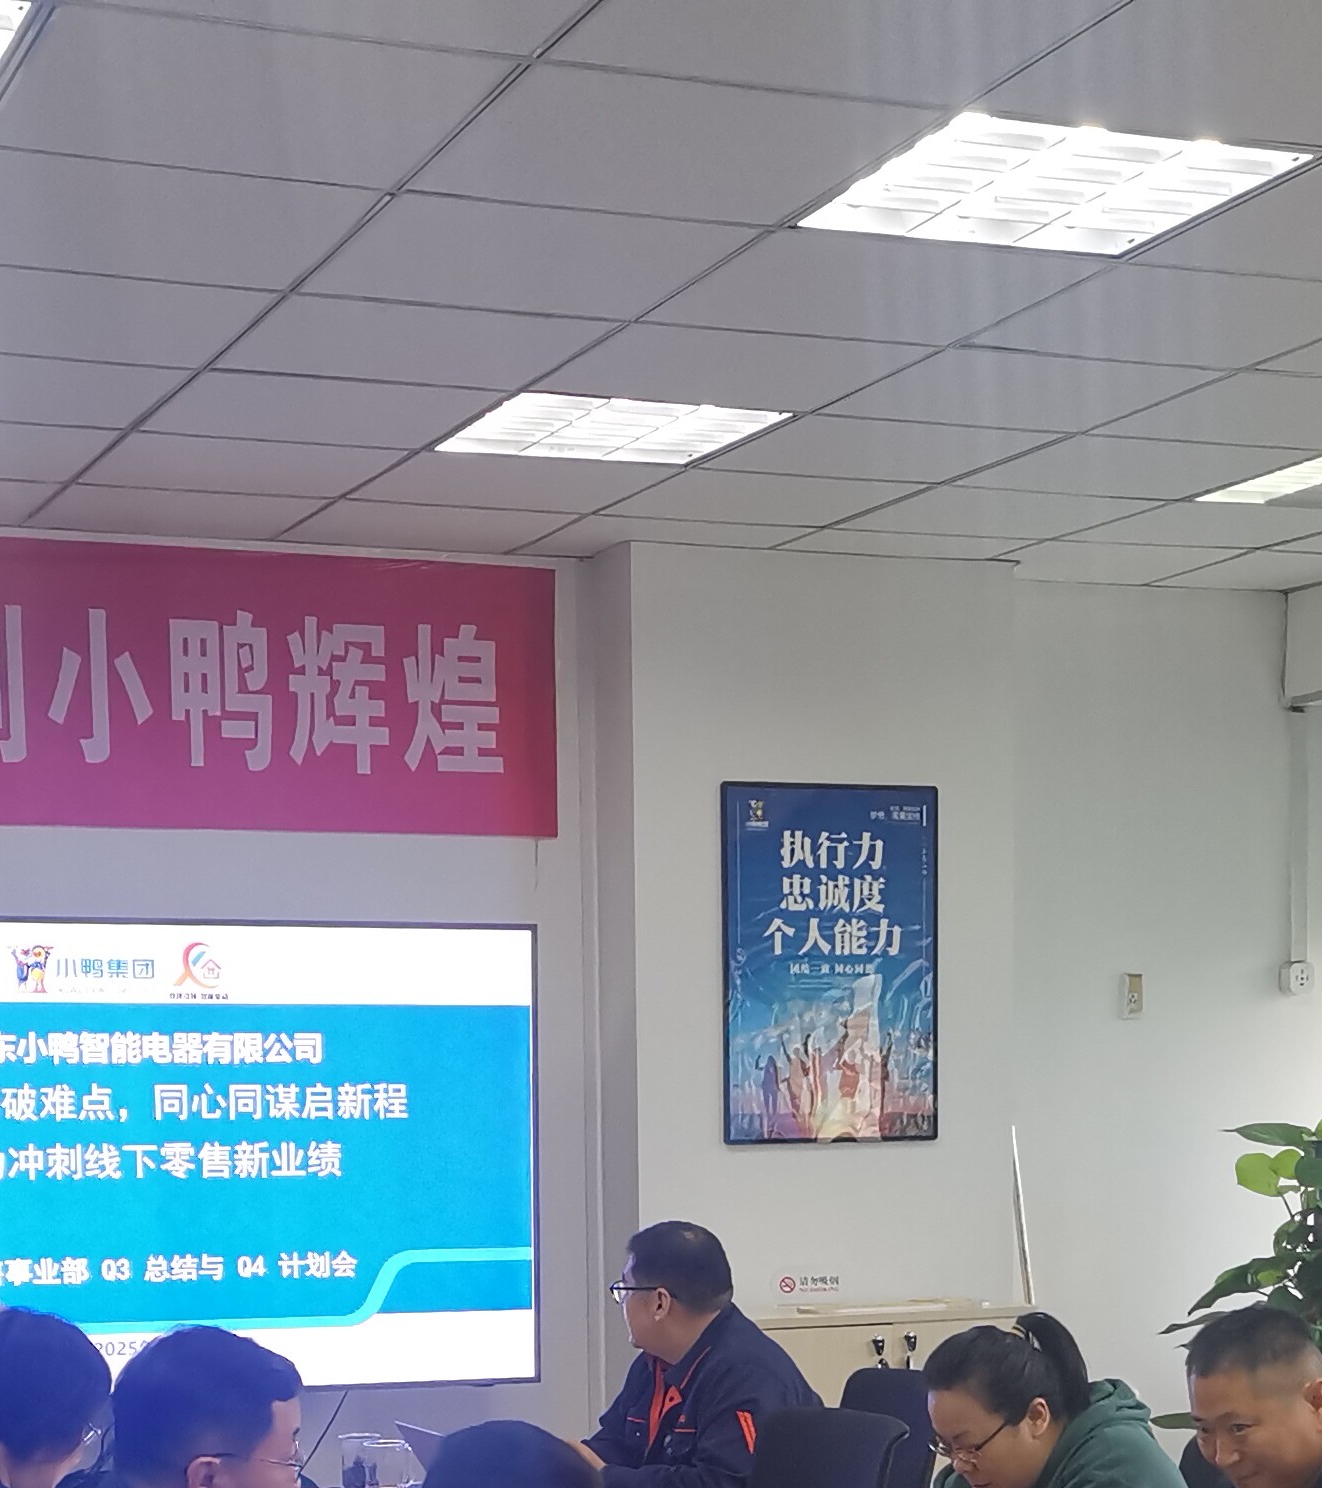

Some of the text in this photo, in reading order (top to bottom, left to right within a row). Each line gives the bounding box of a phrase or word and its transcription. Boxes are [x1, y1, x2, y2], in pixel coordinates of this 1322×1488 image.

[780, 829, 884, 870] 执行力
[779, 874, 886, 914] 忠诚度
[762, 917, 902, 956] 个人能力
[56, 958, 155, 979] 小鸭集团
[101, 1259, 131, 1282] Q3
[144, 1254, 224, 1282] 总结与
[237, 1255, 267, 1279] Q4
[277, 1249, 358, 1279] 计划会
